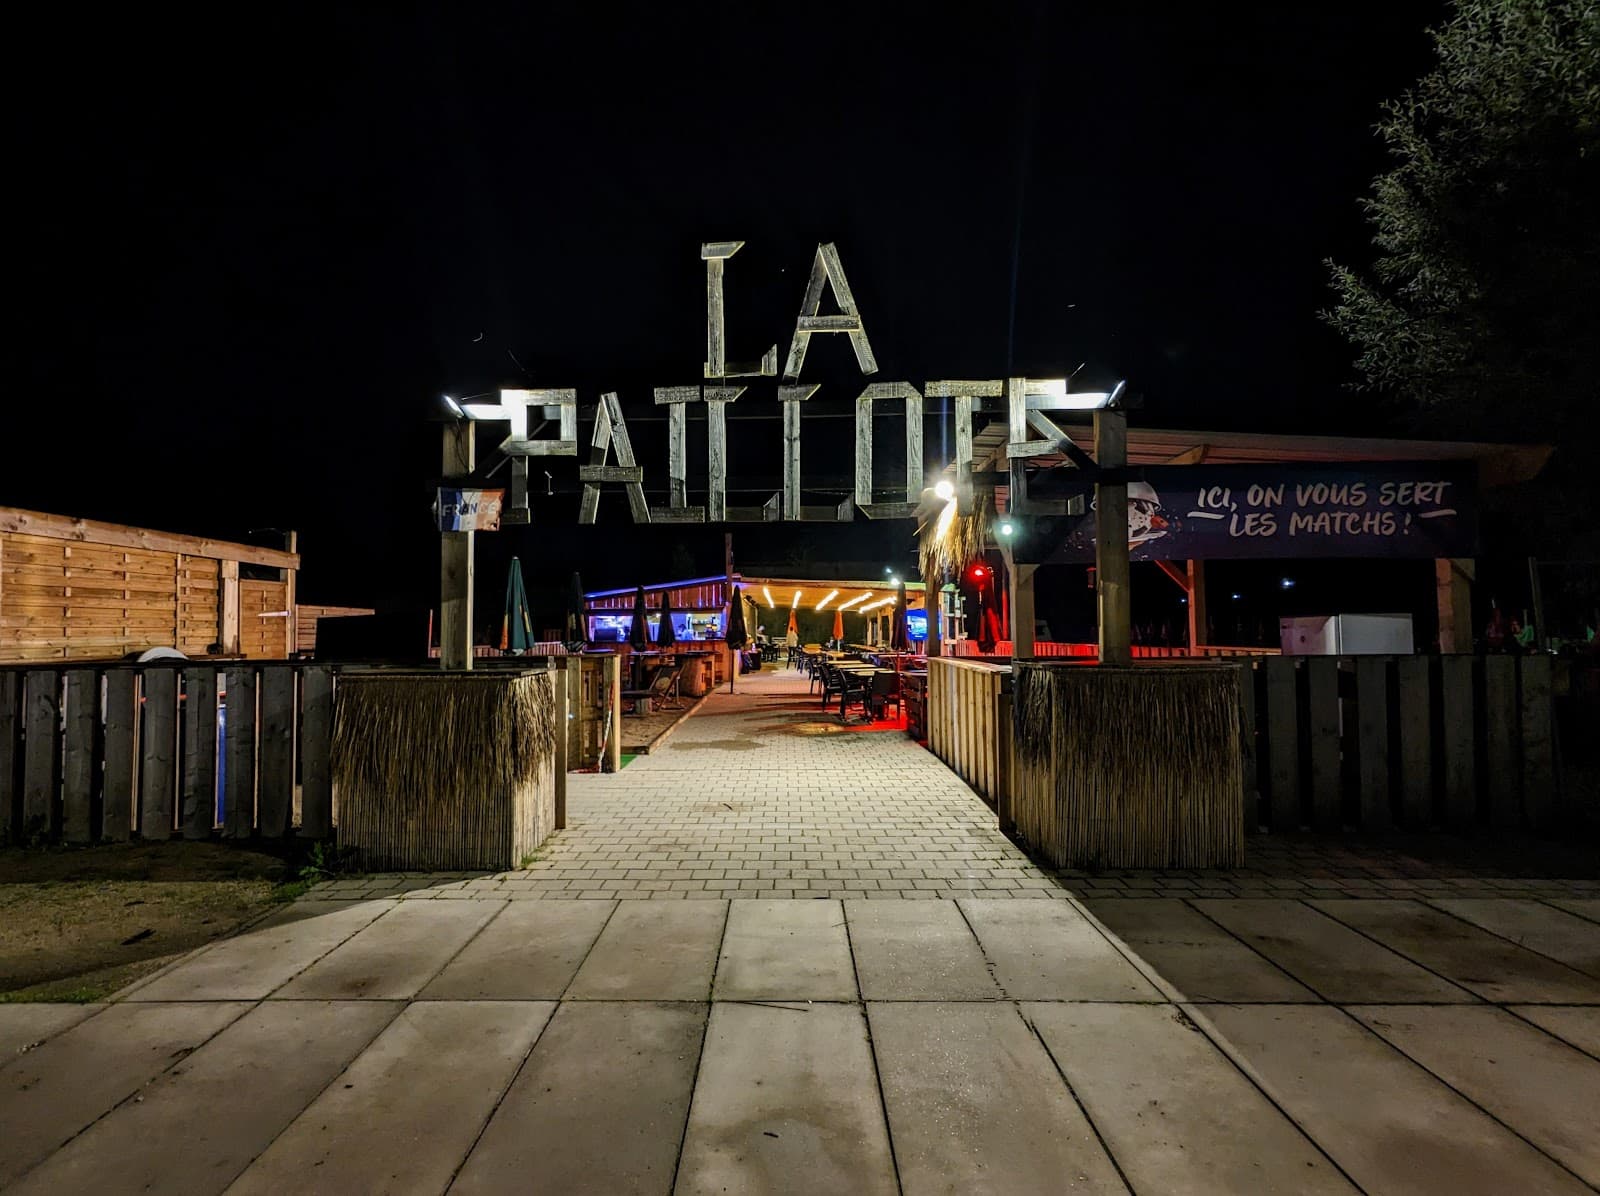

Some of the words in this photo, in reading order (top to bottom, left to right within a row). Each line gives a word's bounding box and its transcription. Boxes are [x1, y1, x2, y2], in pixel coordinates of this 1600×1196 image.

[700, 240, 879, 380] LA
[499, 377, 1085, 525] PAILLOTE
[442, 502, 498, 517] FRANCE
[1198, 485, 1238, 512] ICI,
[1247, 483, 1285, 508] ON
[1296, 482, 1368, 507] VOUS
[1379, 481, 1453, 506] SERT
[1229, 512, 1278, 537] LES
